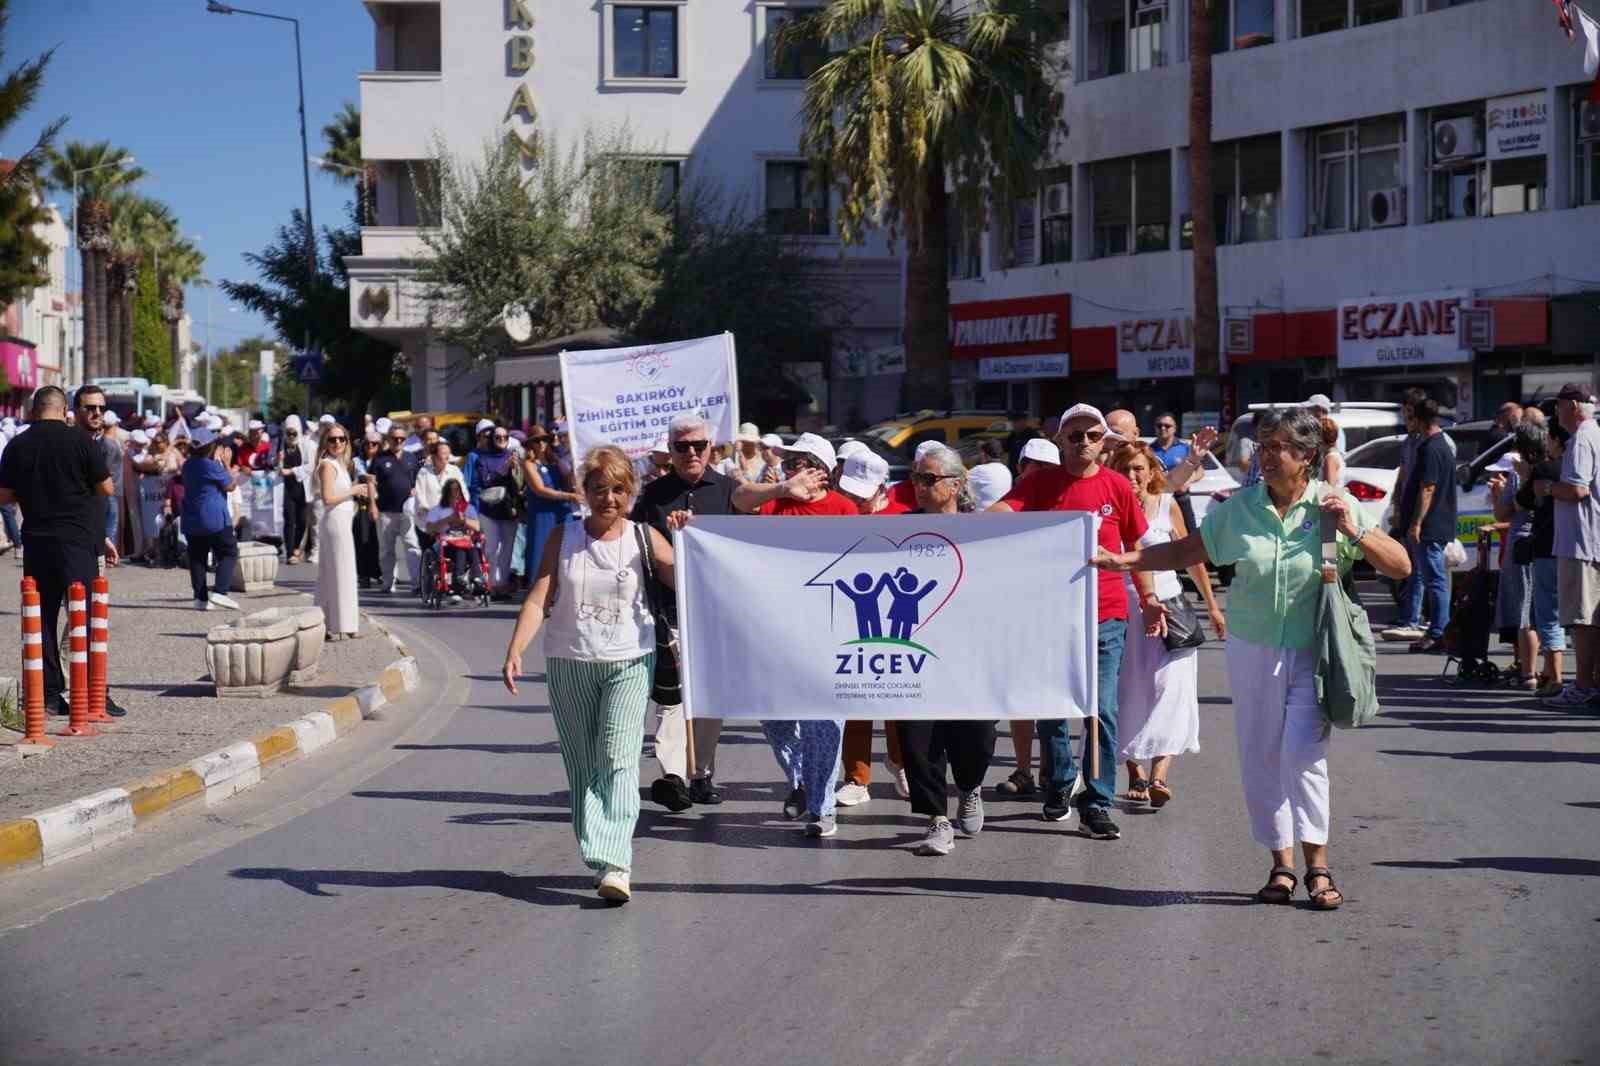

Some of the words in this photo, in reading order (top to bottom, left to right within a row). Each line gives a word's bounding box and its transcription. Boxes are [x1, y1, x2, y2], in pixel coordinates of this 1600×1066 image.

[1343, 299, 1458, 340] ECZANE
[1376, 343, 1424, 361] GÜLTEKİN
[616, 385, 687, 404] BAKIRKÖY
[577, 405, 639, 423] ZİHİNSEL
[643, 392, 729, 415] ENGELLİLERİ
[600, 418, 646, 433] EĞİTİM
[909, 543, 946, 558] 1982
[835, 647, 927, 681] ZİÇEV
